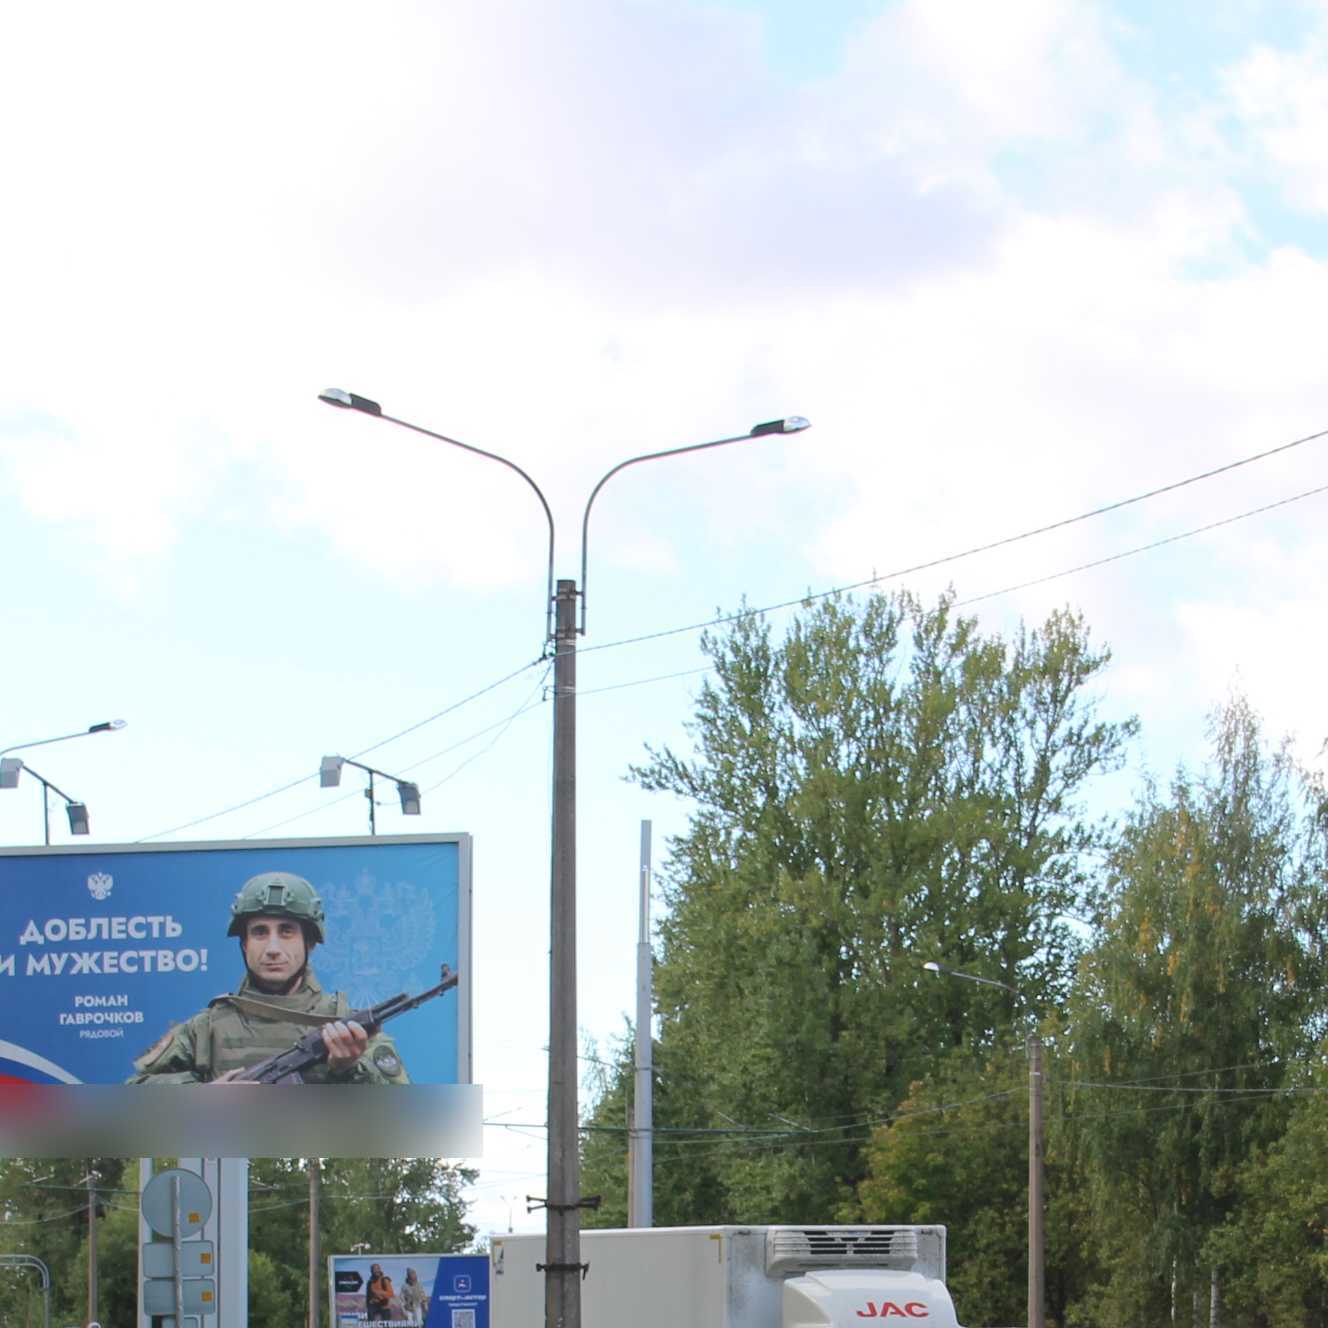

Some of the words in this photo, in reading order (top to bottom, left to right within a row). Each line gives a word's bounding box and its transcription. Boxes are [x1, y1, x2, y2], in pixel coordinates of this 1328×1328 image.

[19, 915, 183, 945] ДОБЛЕСТЬ
[25, 948, 208, 977] МУЖЕСТВО!
[74, 994, 129, 1008] РОМАН
[58, 1010, 145, 1025] ГАВРОЧКОВ
[79, 1027, 124, 1039] РЯДОВОЙ
[856, 1302, 929, 1318] JAC
